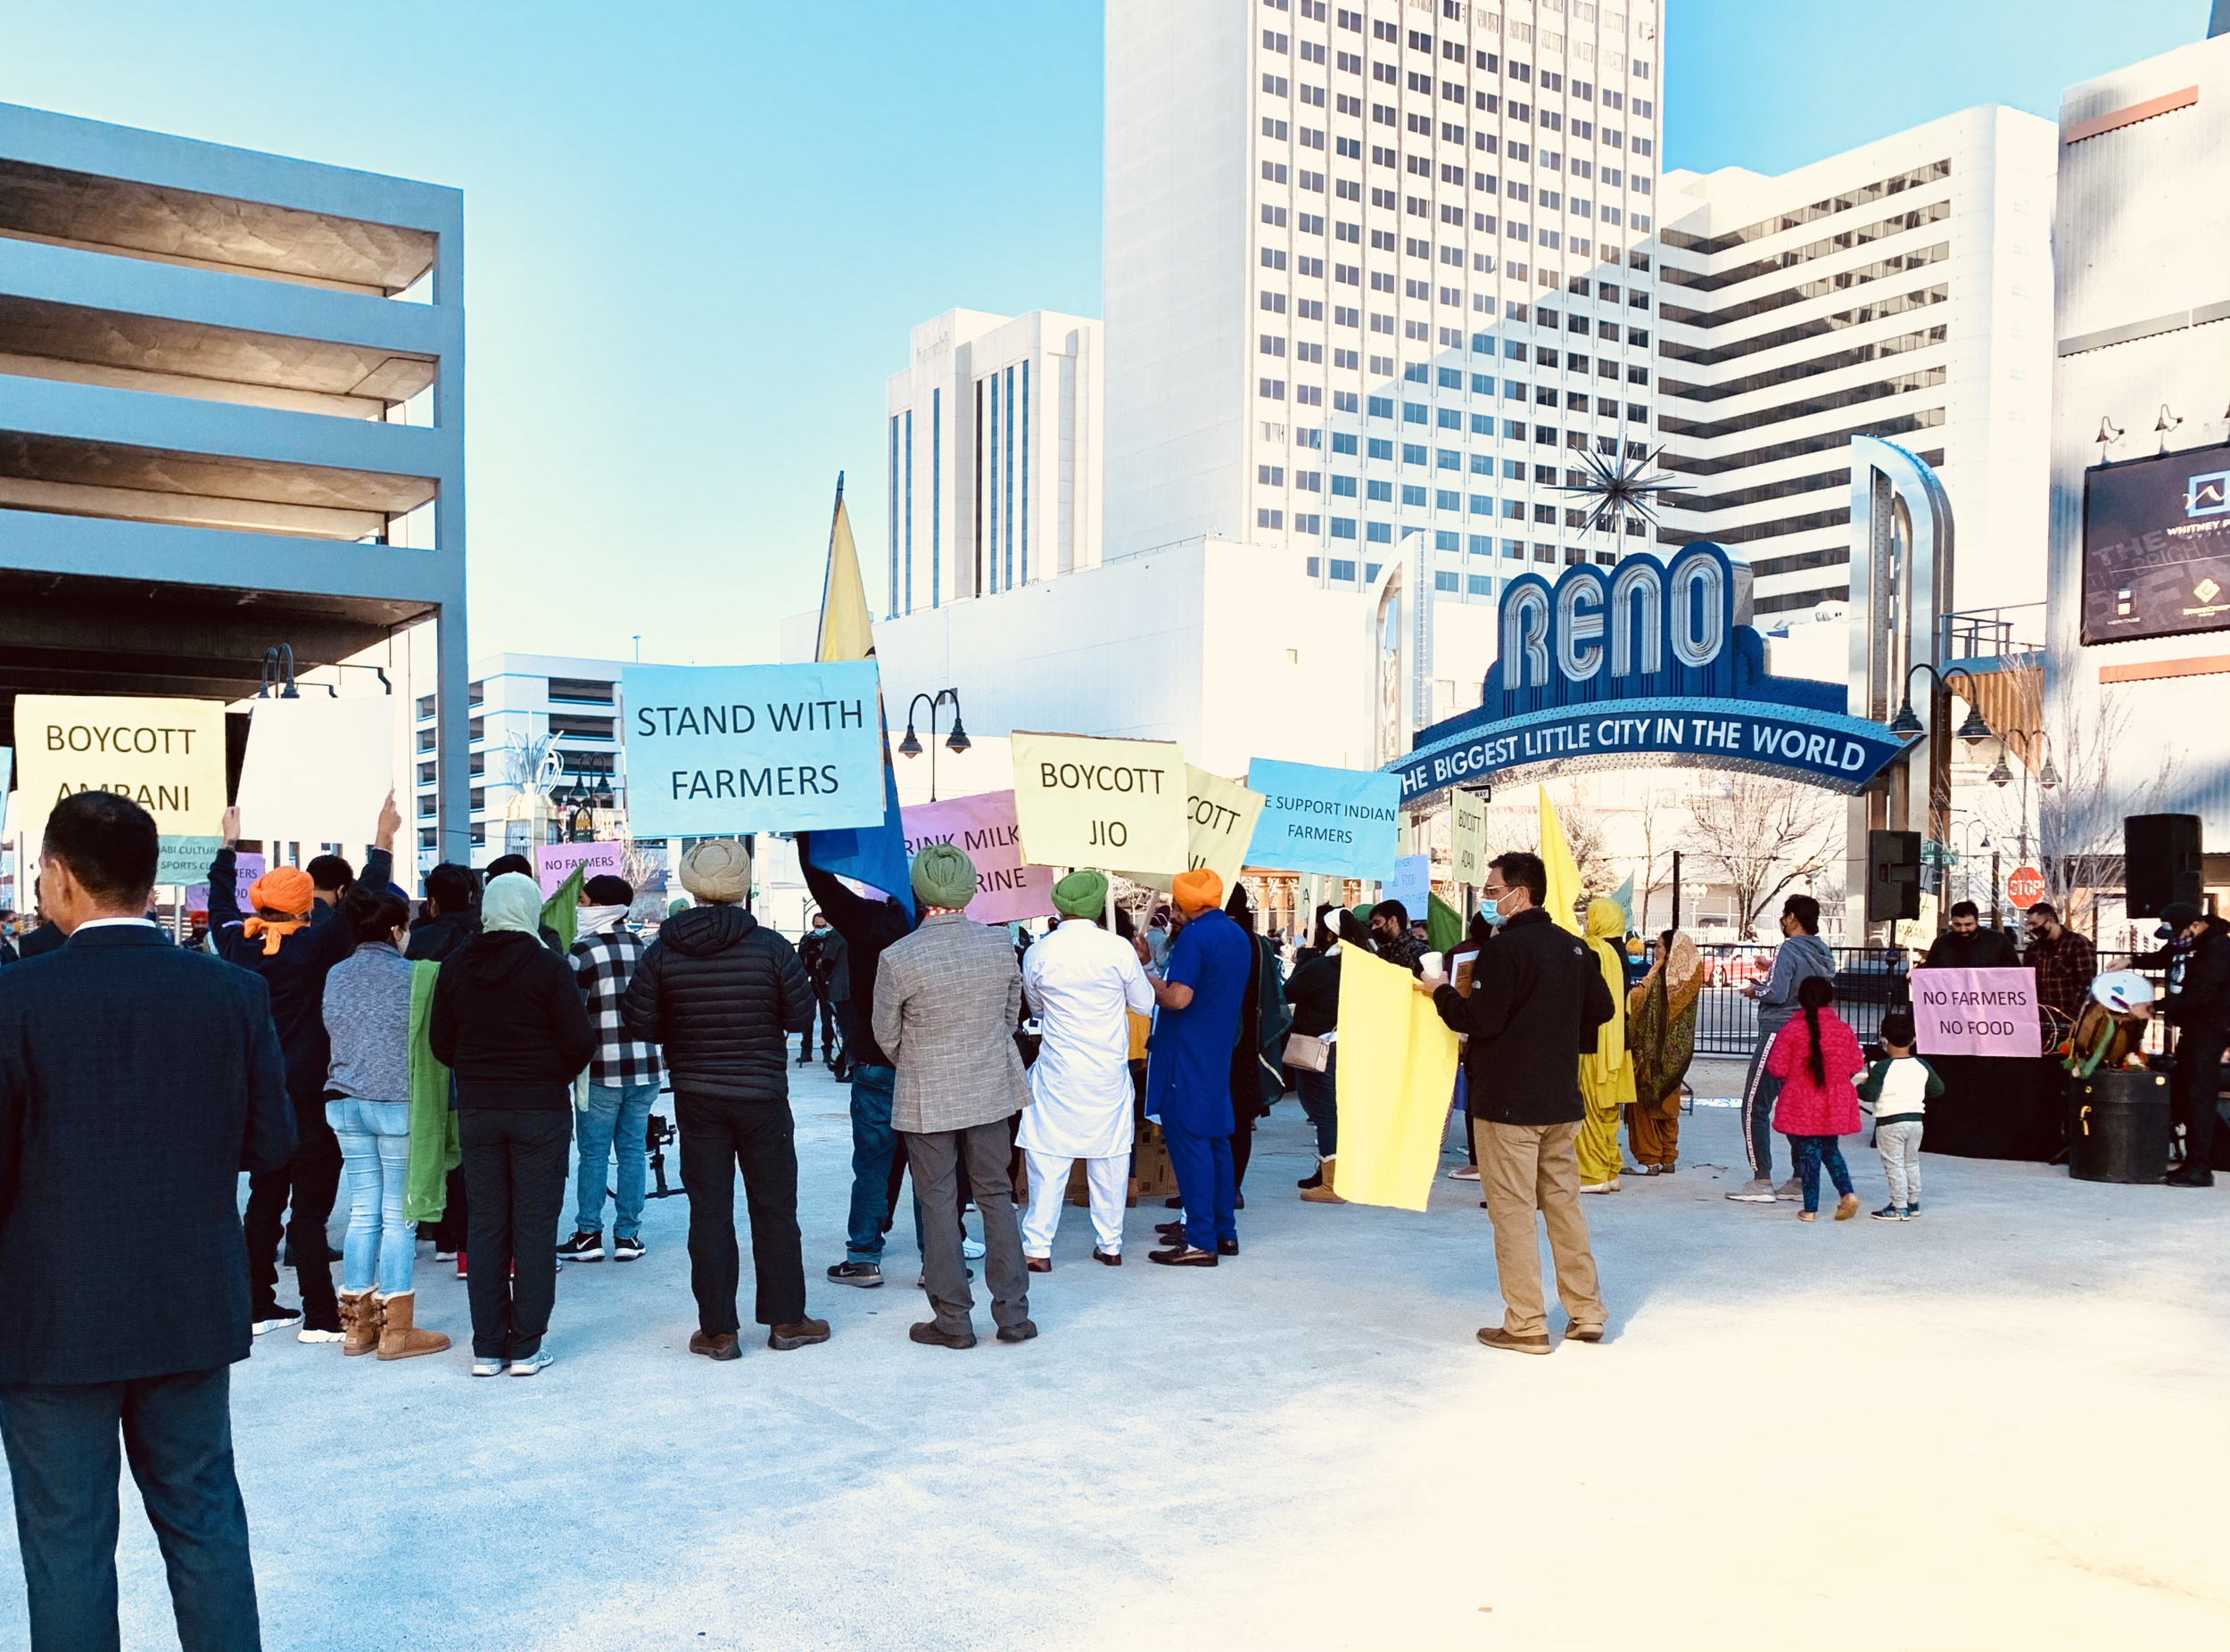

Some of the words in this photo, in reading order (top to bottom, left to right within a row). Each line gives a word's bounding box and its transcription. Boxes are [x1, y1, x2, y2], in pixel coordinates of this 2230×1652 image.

[638, 705, 755, 737] STAND
[767, 699, 863, 732] WITH
[46, 725, 196, 755] BOYCOTT
[1401, 764, 1428, 796] HE
[1433, 736, 1518, 782] BIGGEST
[1524, 723, 1590, 756] LITTLE
[1597, 718, 1651, 746] CITY
[1656, 718, 1684, 744] IN
[1692, 719, 1742, 748] THE
[1753, 724, 1866, 771] WORLD
[672, 764, 839, 800] FARMERS
[1040, 763, 1165, 795] BOYCOTT
[1276, 796, 1342, 816] SUPPORT
[1344, 804, 1396, 822] INDIAN
[904, 833, 954, 855] RINK
[964, 824, 1020, 851] MILK
[1089, 820, 1127, 847] JIO
[1287, 824, 1353, 844] FARMERS
[161, 861, 197, 870] SPORTS
[545, 860, 562, 871] NO
[975, 868, 1027, 893] RINE
[2010, 880, 2042, 896] STOP
[1923, 991, 1947, 1005] NO
[1952, 991, 2027, 1006] FARMERS
[1939, 1020, 1962, 1035] NO
[1968, 1020, 2014, 1036] FOOD
